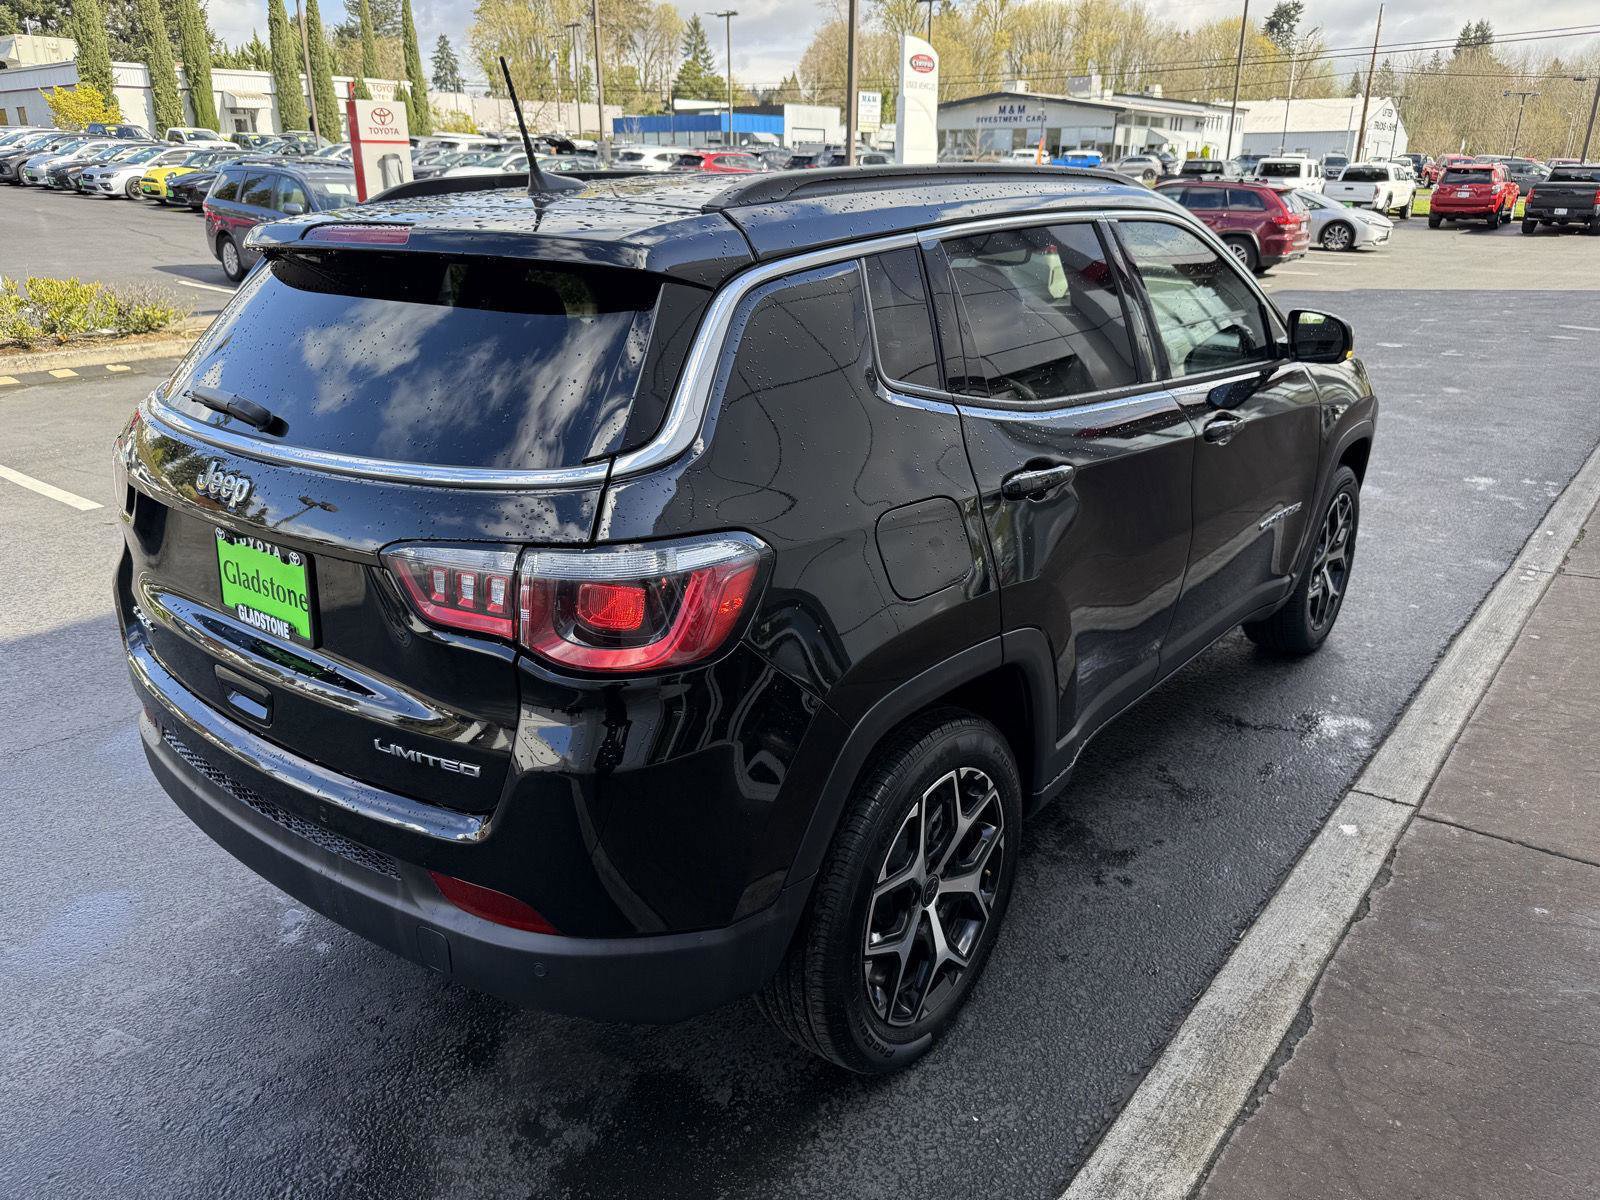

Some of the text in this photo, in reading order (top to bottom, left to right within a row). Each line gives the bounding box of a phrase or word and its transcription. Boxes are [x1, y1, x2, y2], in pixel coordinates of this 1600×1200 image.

[369, 127, 400, 136] TOYOTA
[976, 115, 1022, 123] INVESTMENT
[195, 461, 251, 511] Jeep
[223, 559, 309, 612] Gladstone
[237, 605, 290, 640] GLADSTONE
[374, 738, 482, 778] LIMITED
